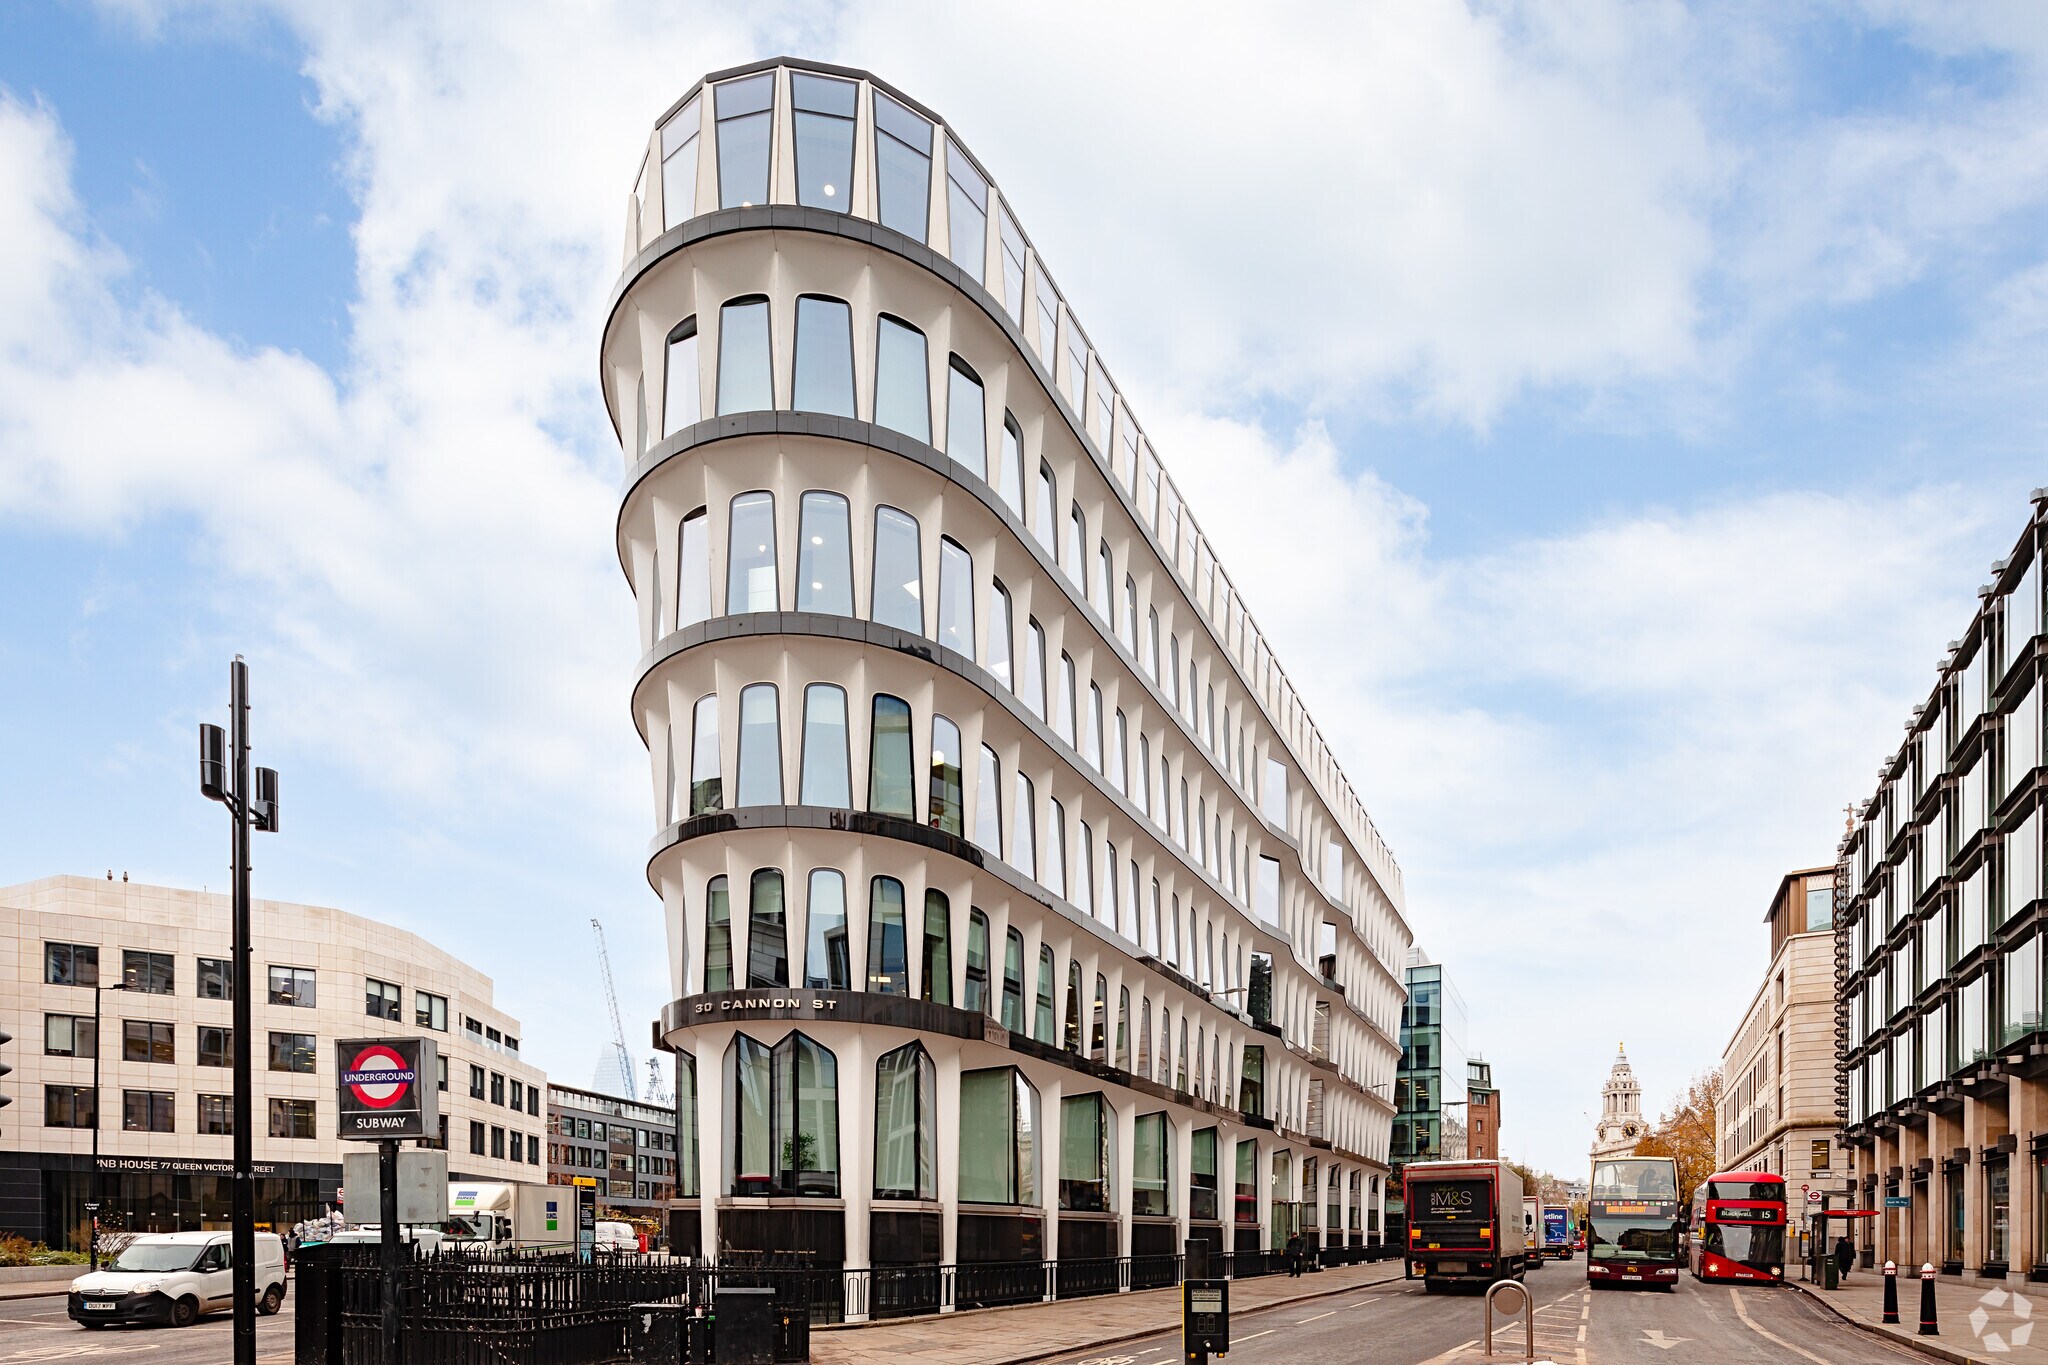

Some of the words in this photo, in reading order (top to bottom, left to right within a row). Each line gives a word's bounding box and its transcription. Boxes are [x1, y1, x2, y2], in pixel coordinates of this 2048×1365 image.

[695, 1003, 713, 1014] 30
[721, 998, 800, 1010] CANNON
[812, 999, 837, 1010] ST
[344, 1072, 414, 1082] UNDERGROUND
[356, 1118, 406, 1128] SUBWAY
[119, 1159, 158, 1170] HOUSE
[160, 1161, 171, 1170] 77
[172, 1162, 202, 1171] QUEEN
[1436, 1191, 1472, 1206] M&S
[1721, 1210, 1752, 1218] Blackwall
